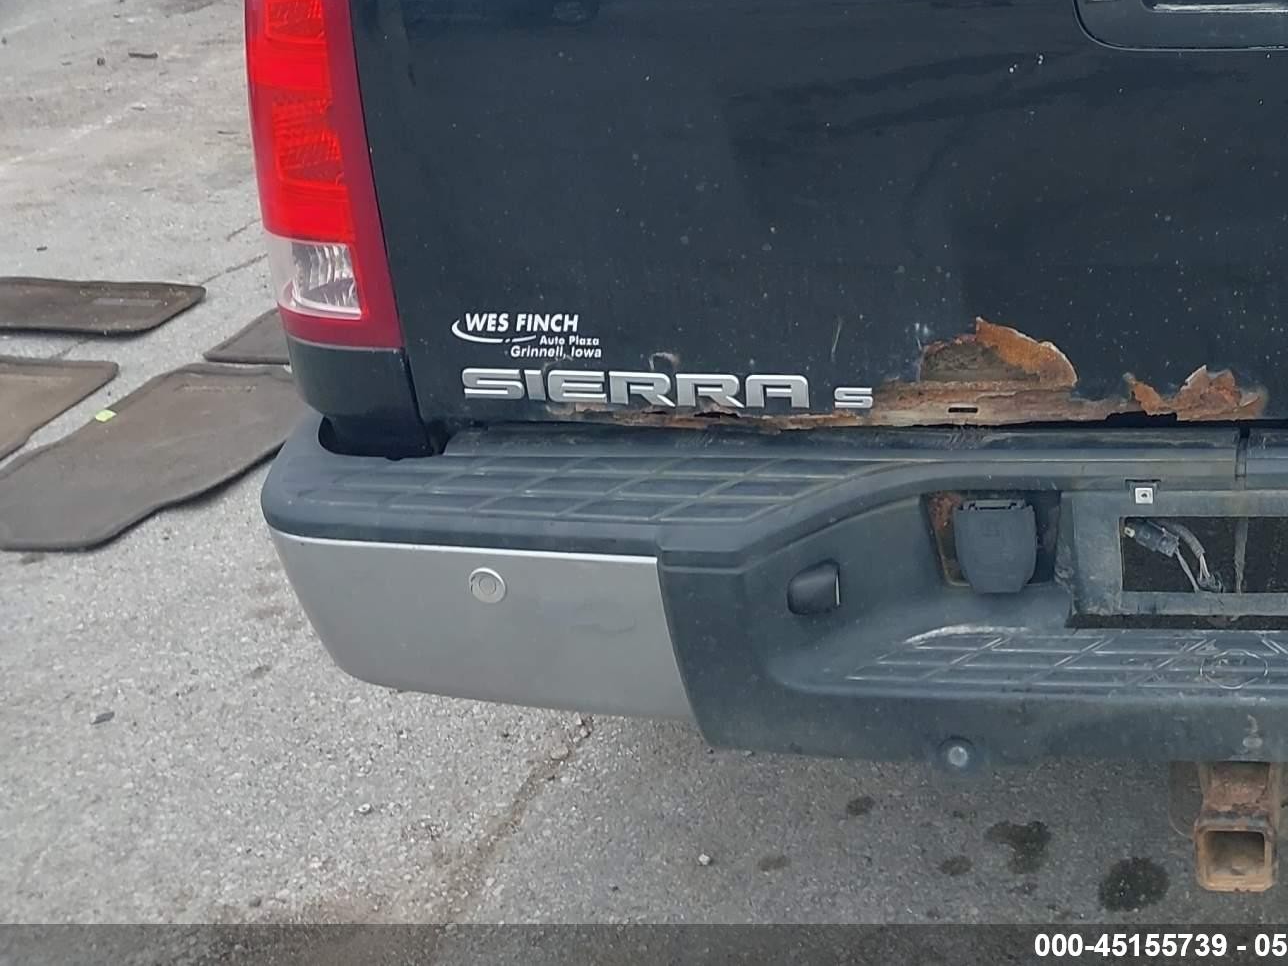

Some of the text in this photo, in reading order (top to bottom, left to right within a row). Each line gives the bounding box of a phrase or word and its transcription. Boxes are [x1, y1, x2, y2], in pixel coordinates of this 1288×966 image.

[465, 313, 579, 333] WES FINCH
[539, 335, 600, 346] Auto Plaza
[510, 345, 602, 359] Grinnell, Iowa
[461, 367, 810, 409] SIERRA
